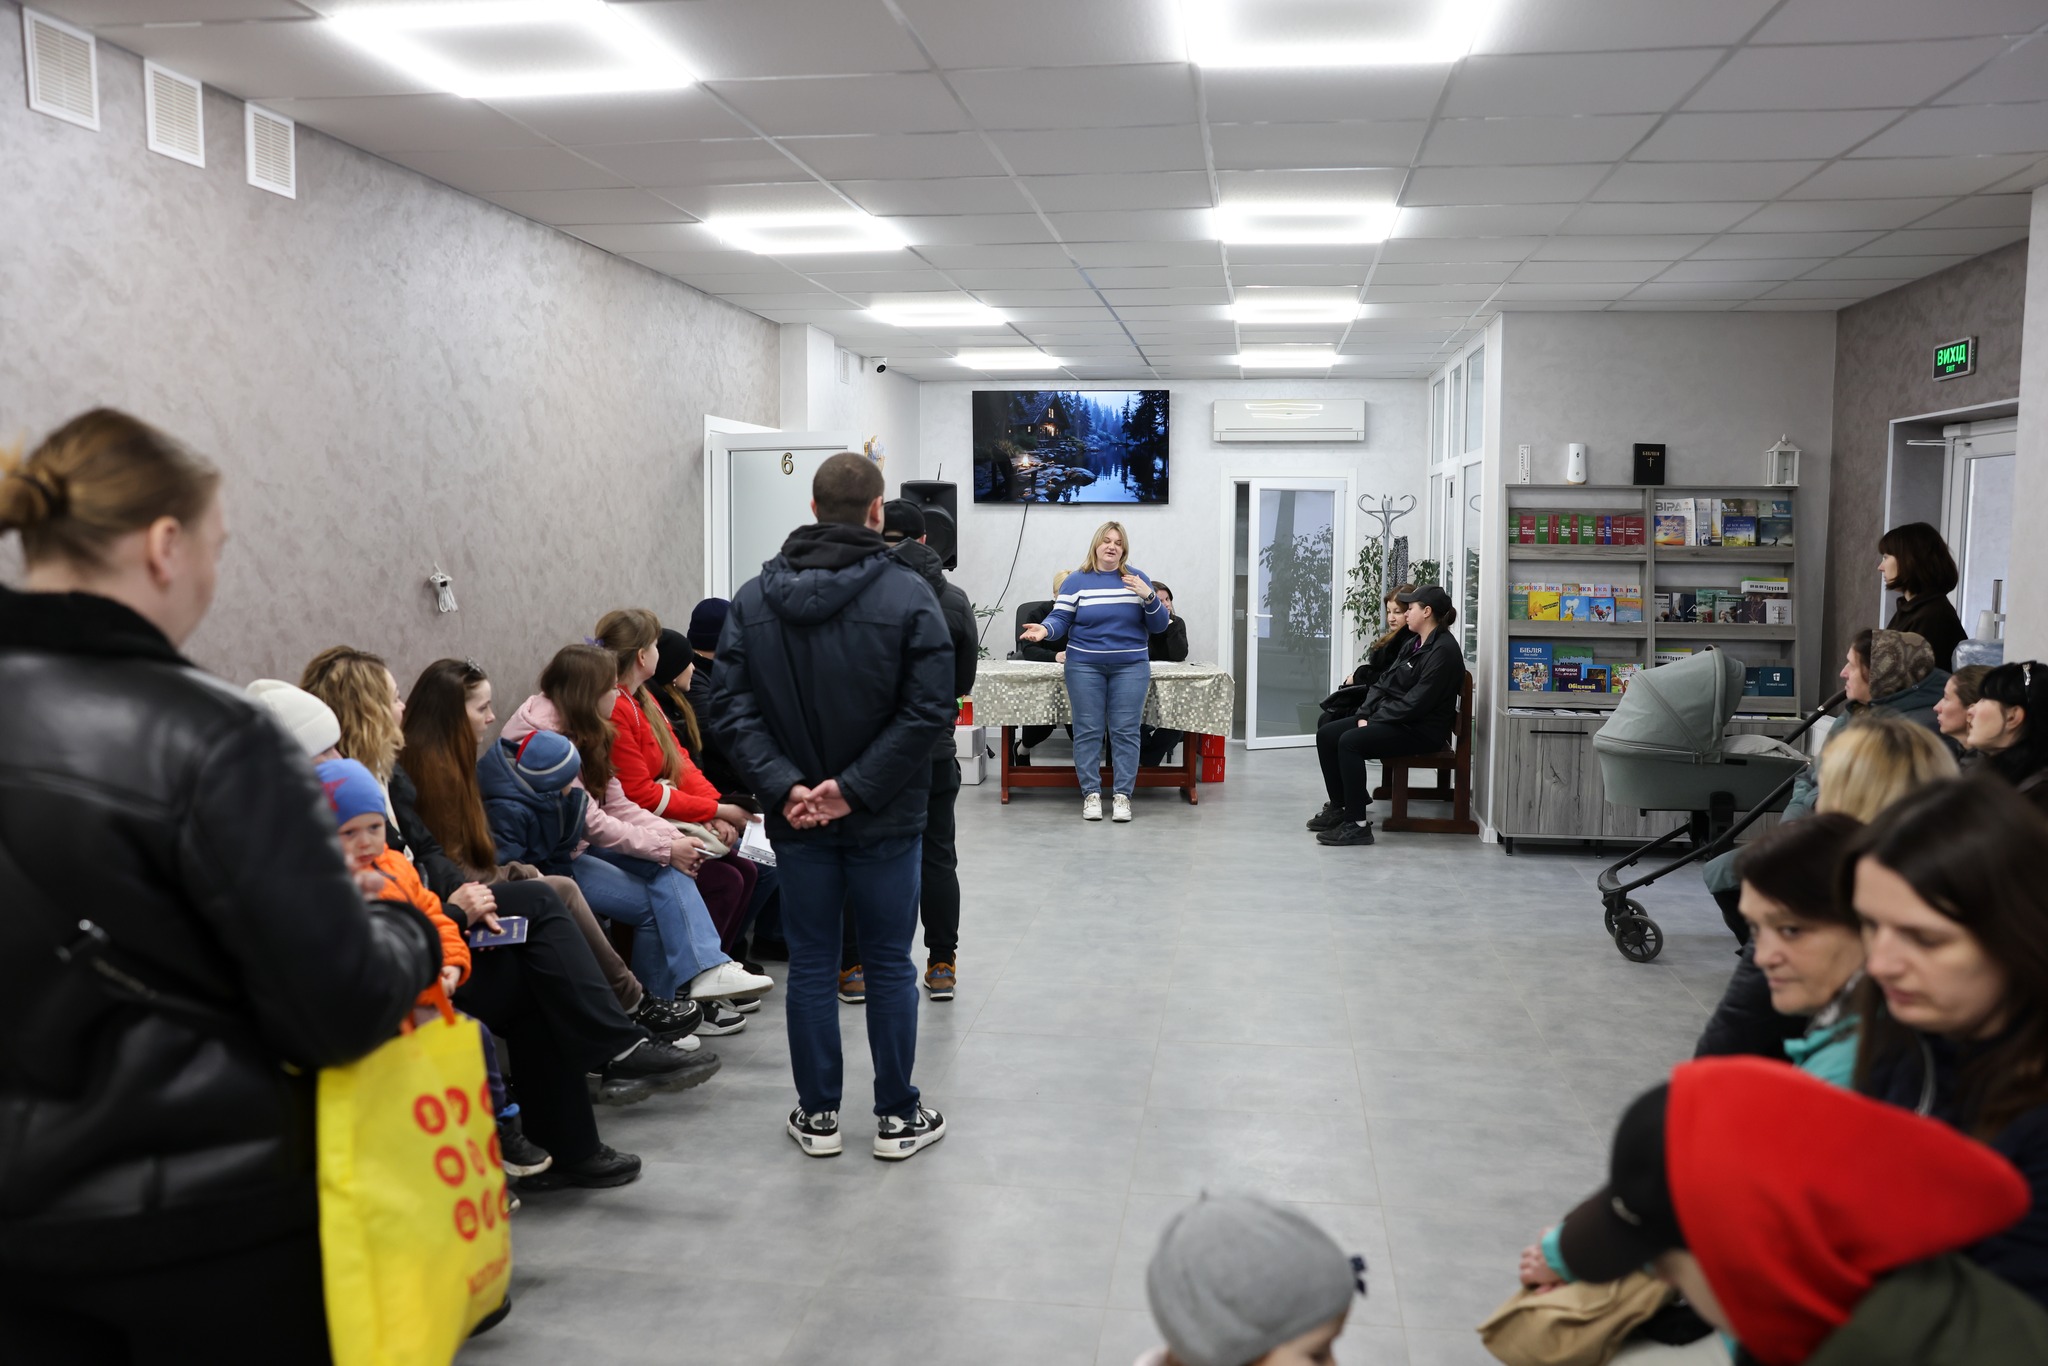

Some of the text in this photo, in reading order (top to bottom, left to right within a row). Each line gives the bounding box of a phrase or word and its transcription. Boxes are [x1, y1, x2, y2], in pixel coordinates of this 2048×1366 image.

[1937, 343, 1966, 366] ВИХІД
[1945, 364, 1956, 373] EXIT
[781, 452, 794, 475] 6
